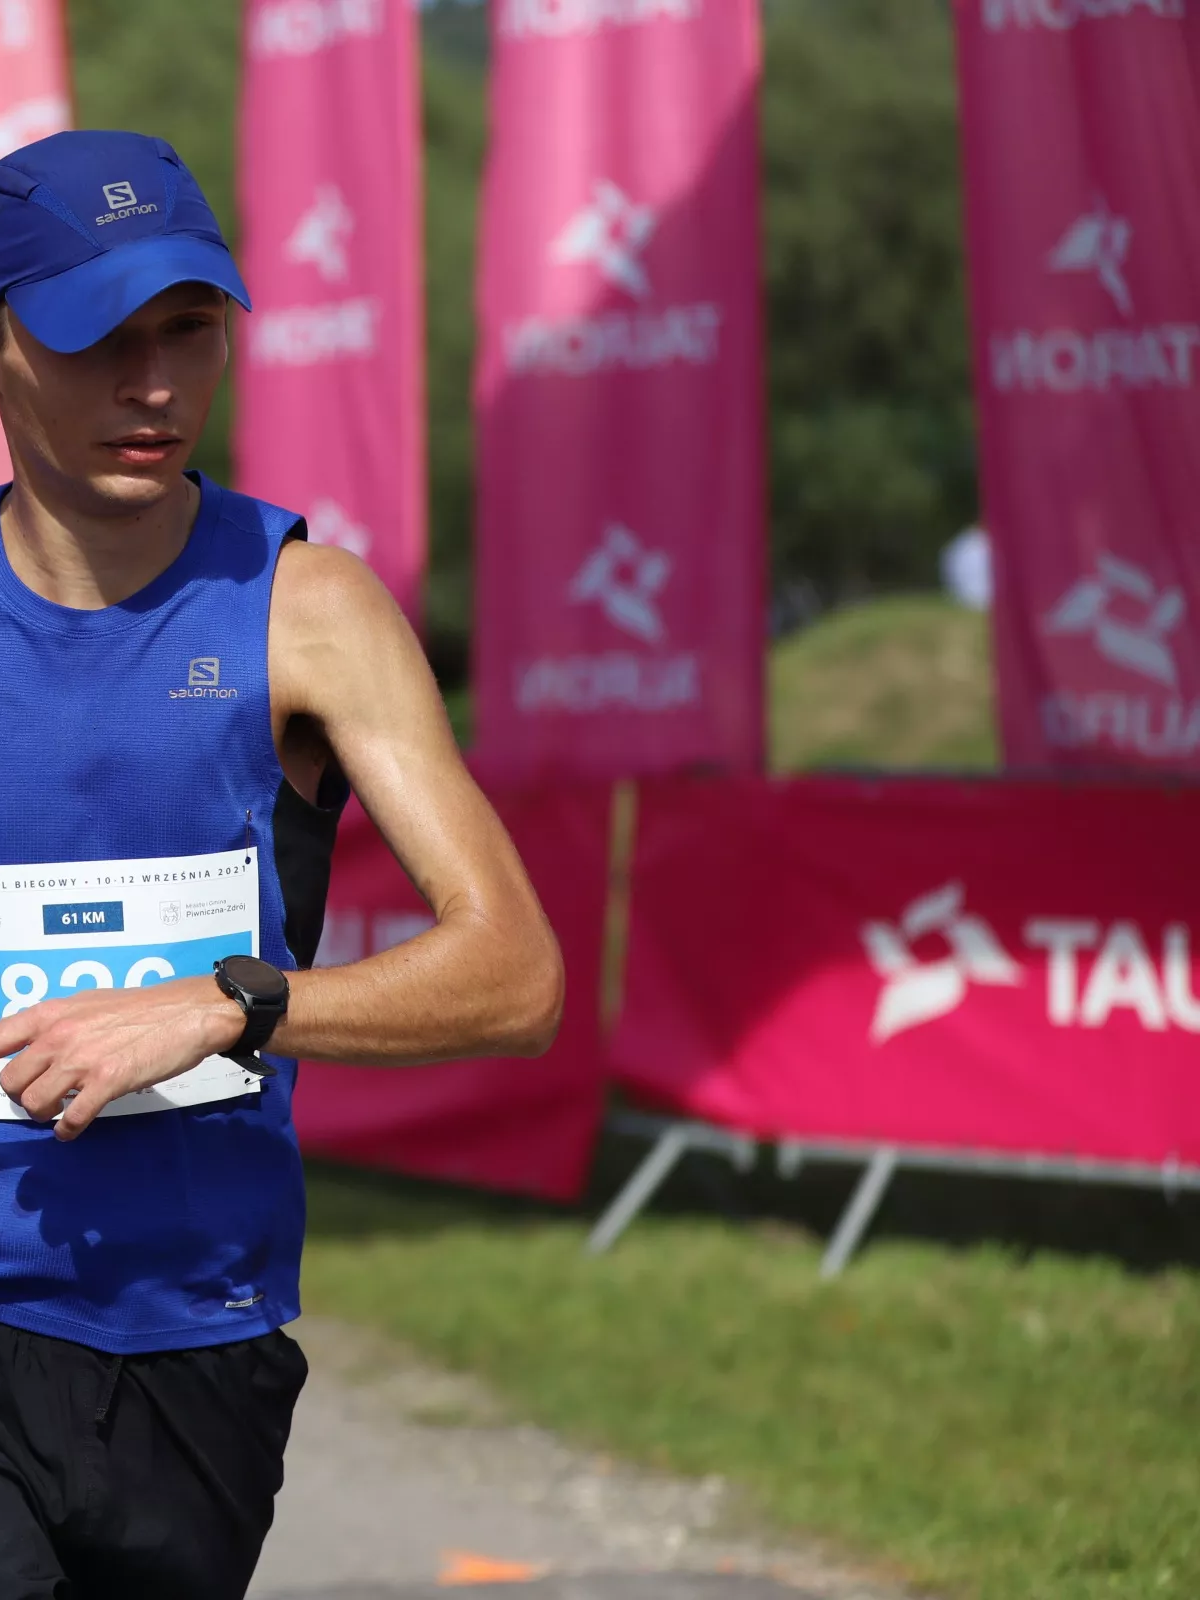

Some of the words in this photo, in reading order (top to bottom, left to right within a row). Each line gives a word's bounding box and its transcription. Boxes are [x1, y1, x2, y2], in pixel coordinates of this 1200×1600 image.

[15, 878, 78, 889] BIEGOWY
[142, 869, 211, 883] WRZEŚNIA
[218, 865, 247, 876] 2021
[186, 904, 246, 917] Piwniczna-Zdrój
[61, 912, 78, 925] 61
[82, 911, 105, 924] KM
